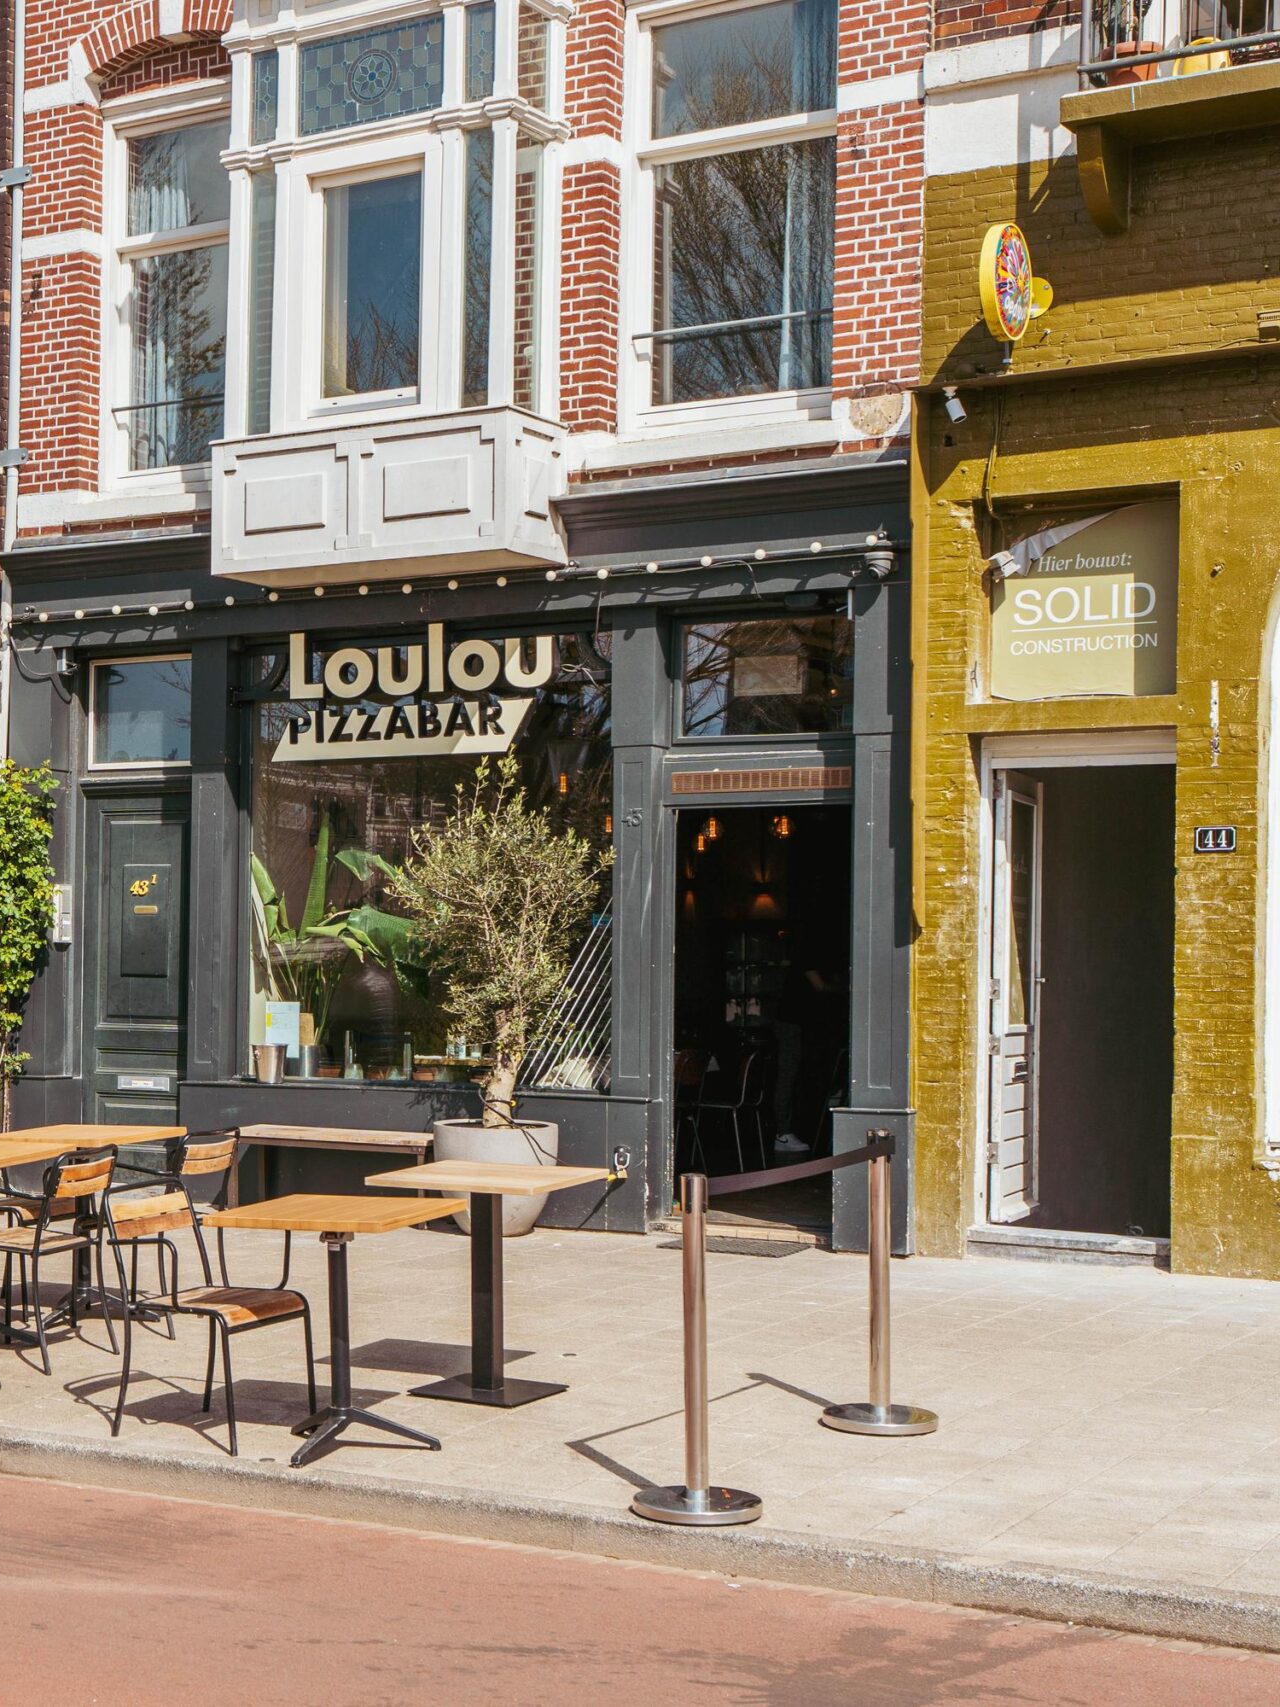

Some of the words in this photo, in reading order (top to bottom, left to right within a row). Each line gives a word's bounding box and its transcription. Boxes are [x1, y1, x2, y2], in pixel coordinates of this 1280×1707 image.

[1037, 555, 1074, 573] Hier
[1075, 552, 1133, 570] bouwt:
[1013, 582, 1157, 626] SOLID
[289, 622, 554, 699] Loulou
[1010, 632, 1158, 656] CONSTRUCTION
[288, 701, 506, 745] PIZZABAR
[1204, 830, 1228, 848] 44
